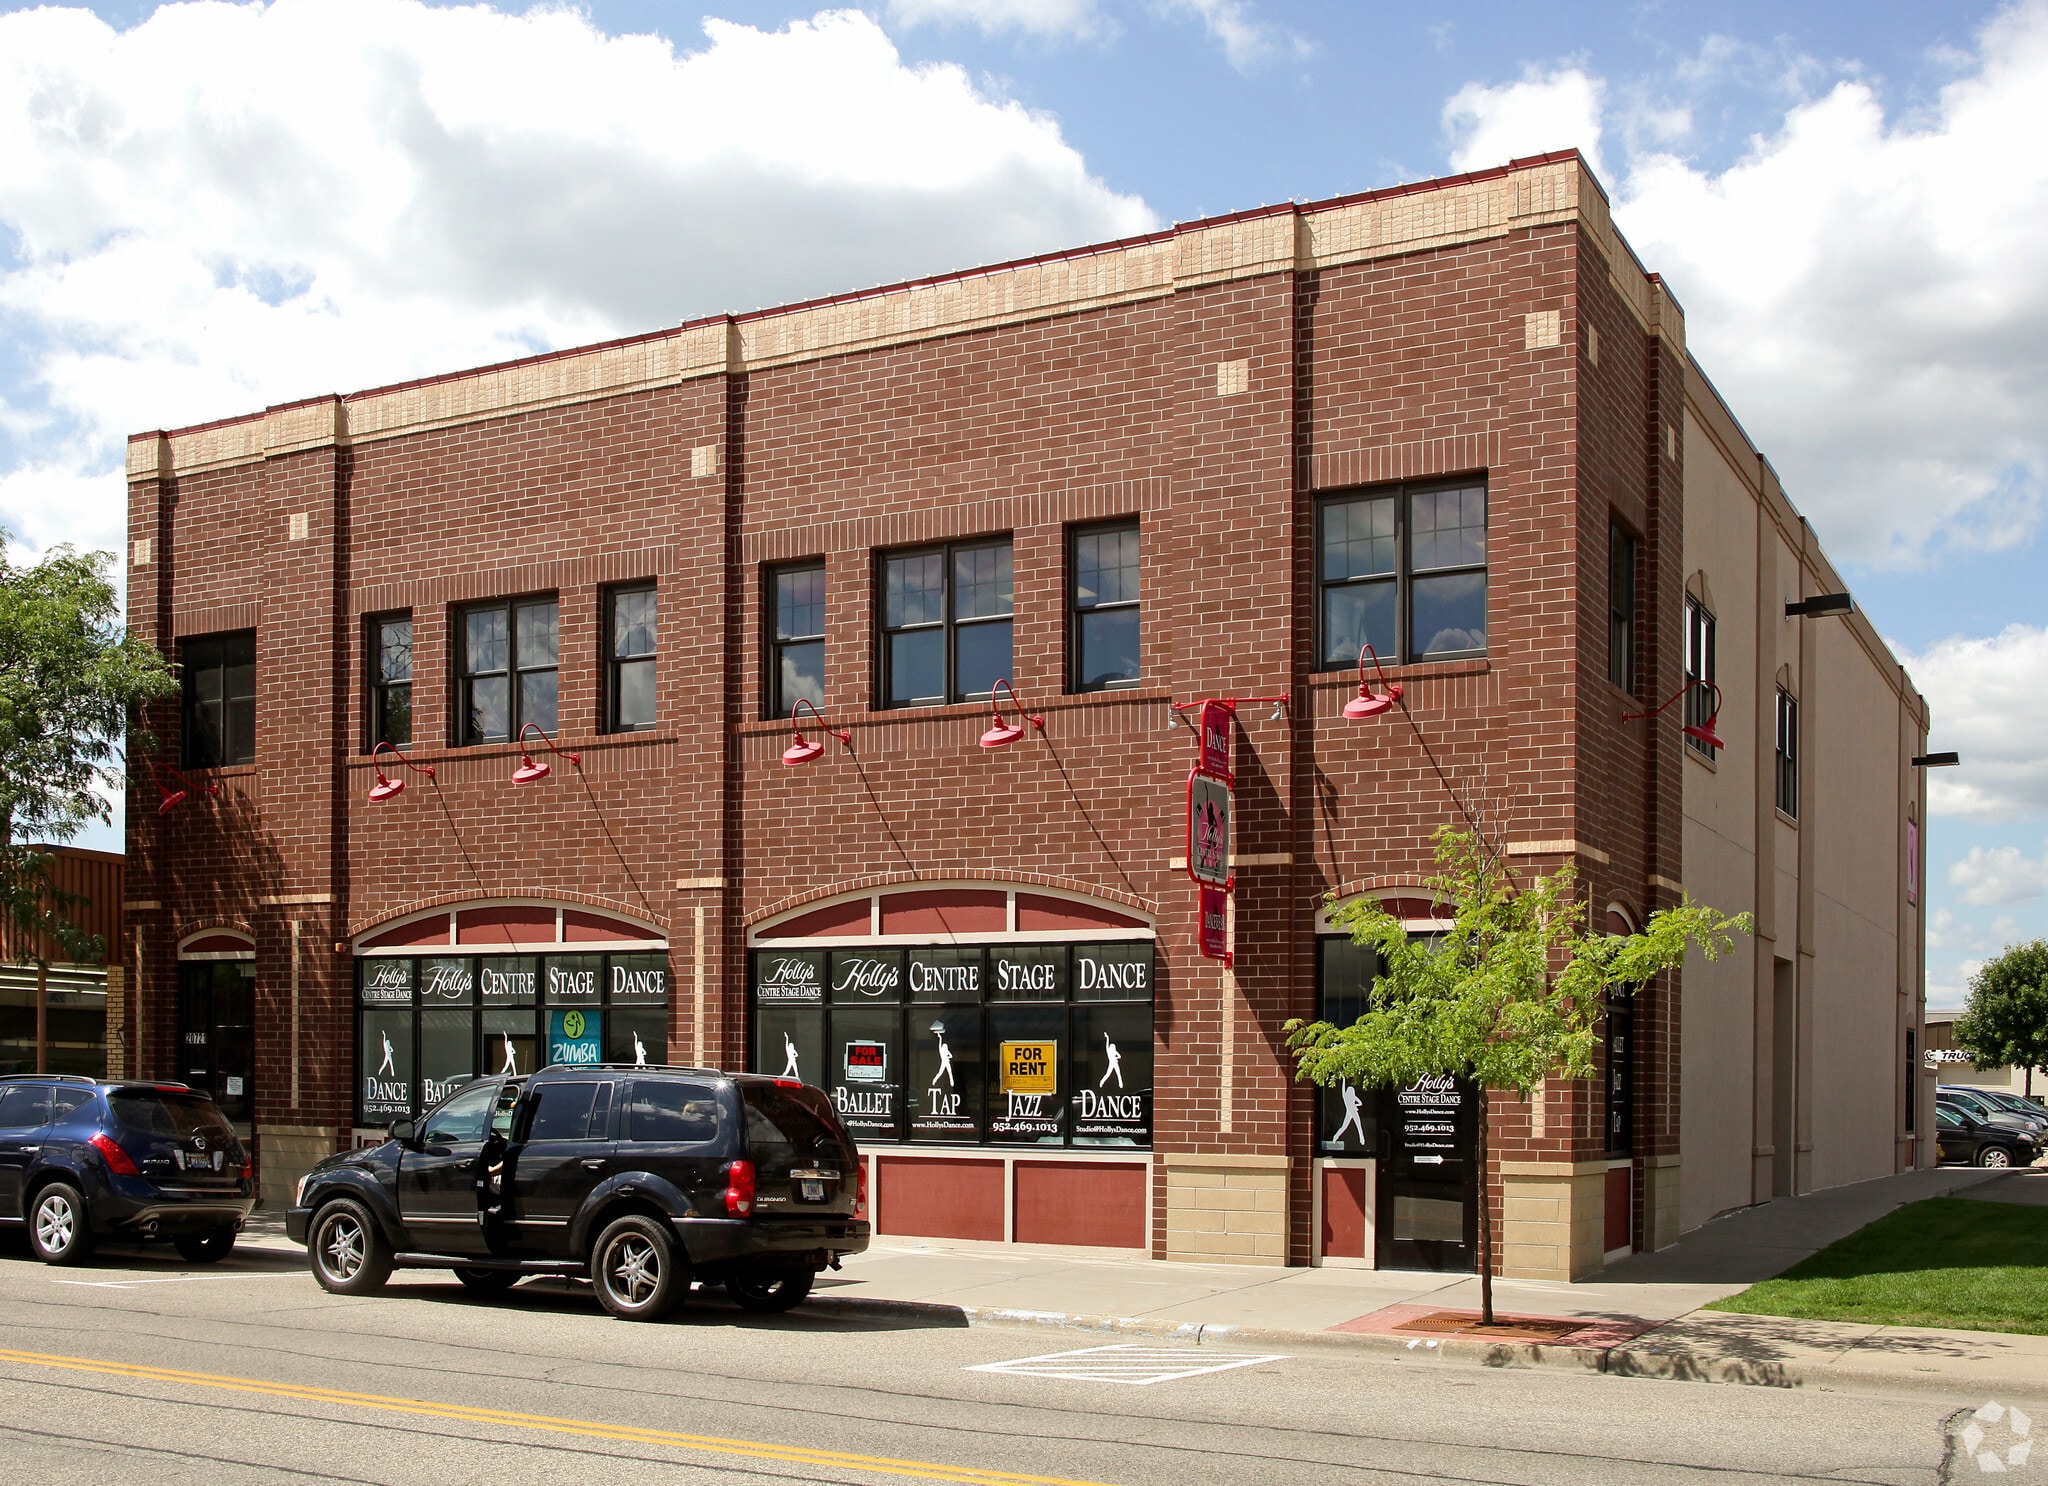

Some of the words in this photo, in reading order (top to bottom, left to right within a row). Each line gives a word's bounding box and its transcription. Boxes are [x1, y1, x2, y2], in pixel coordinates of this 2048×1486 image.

[1207, 726, 1227, 753] DANCE
[368, 965, 407, 990] Holly's
[765, 958, 815, 986] Holly's
[832, 958, 898, 996] Holly's
[909, 961, 979, 992] CENTRE
[998, 959, 1055, 990] STAGE
[1079, 958, 1147, 989] DANCE
[420, 966, 473, 998] Holly's
[481, 968, 535, 994] CENTRE
[549, 967, 594, 994] STAGE
[612, 966, 665, 993] DANCE
[757, 985, 780, 997] CENTRE
[780, 985, 799, 997] STAGE
[800, 985, 822, 997] DANCE
[362, 990, 380, 999] CENTRE
[380, 989, 396, 999] STAGE
[396, 989, 412, 999] DANCE
[552, 1042, 598, 1063] ZUMBA
[850, 1055, 882, 1065] SALE
[855, 1047, 877, 1056] FOR
[1014, 1047, 1042, 1061] FOR
[1009, 1061, 1047, 1076] RENT
[366, 1076, 407, 1101] DANCE
[1405, 1071, 1455, 1095] Holly's
[835, 1086, 893, 1114] BALLET
[928, 1088, 961, 1115] TAP
[1005, 1089, 1043, 1121] JAZZ
[1079, 1089, 1142, 1119] DANCE
[1397, 1094, 1420, 1104] CENTRE
[1421, 1094, 1440, 1104] STAGE
[1440, 1094, 1462, 1104] DANCE
[363, 1104, 411, 1115] 952.469.1013
[912, 1121, 975, 1130] www.HollysDance.com
[992, 1122, 1058, 1134] 952.469.1013
[1075, 1125, 1147, 1134] Studio@HollysDance.com
[1404, 1124, 1455, 1133] 952.469.1013
